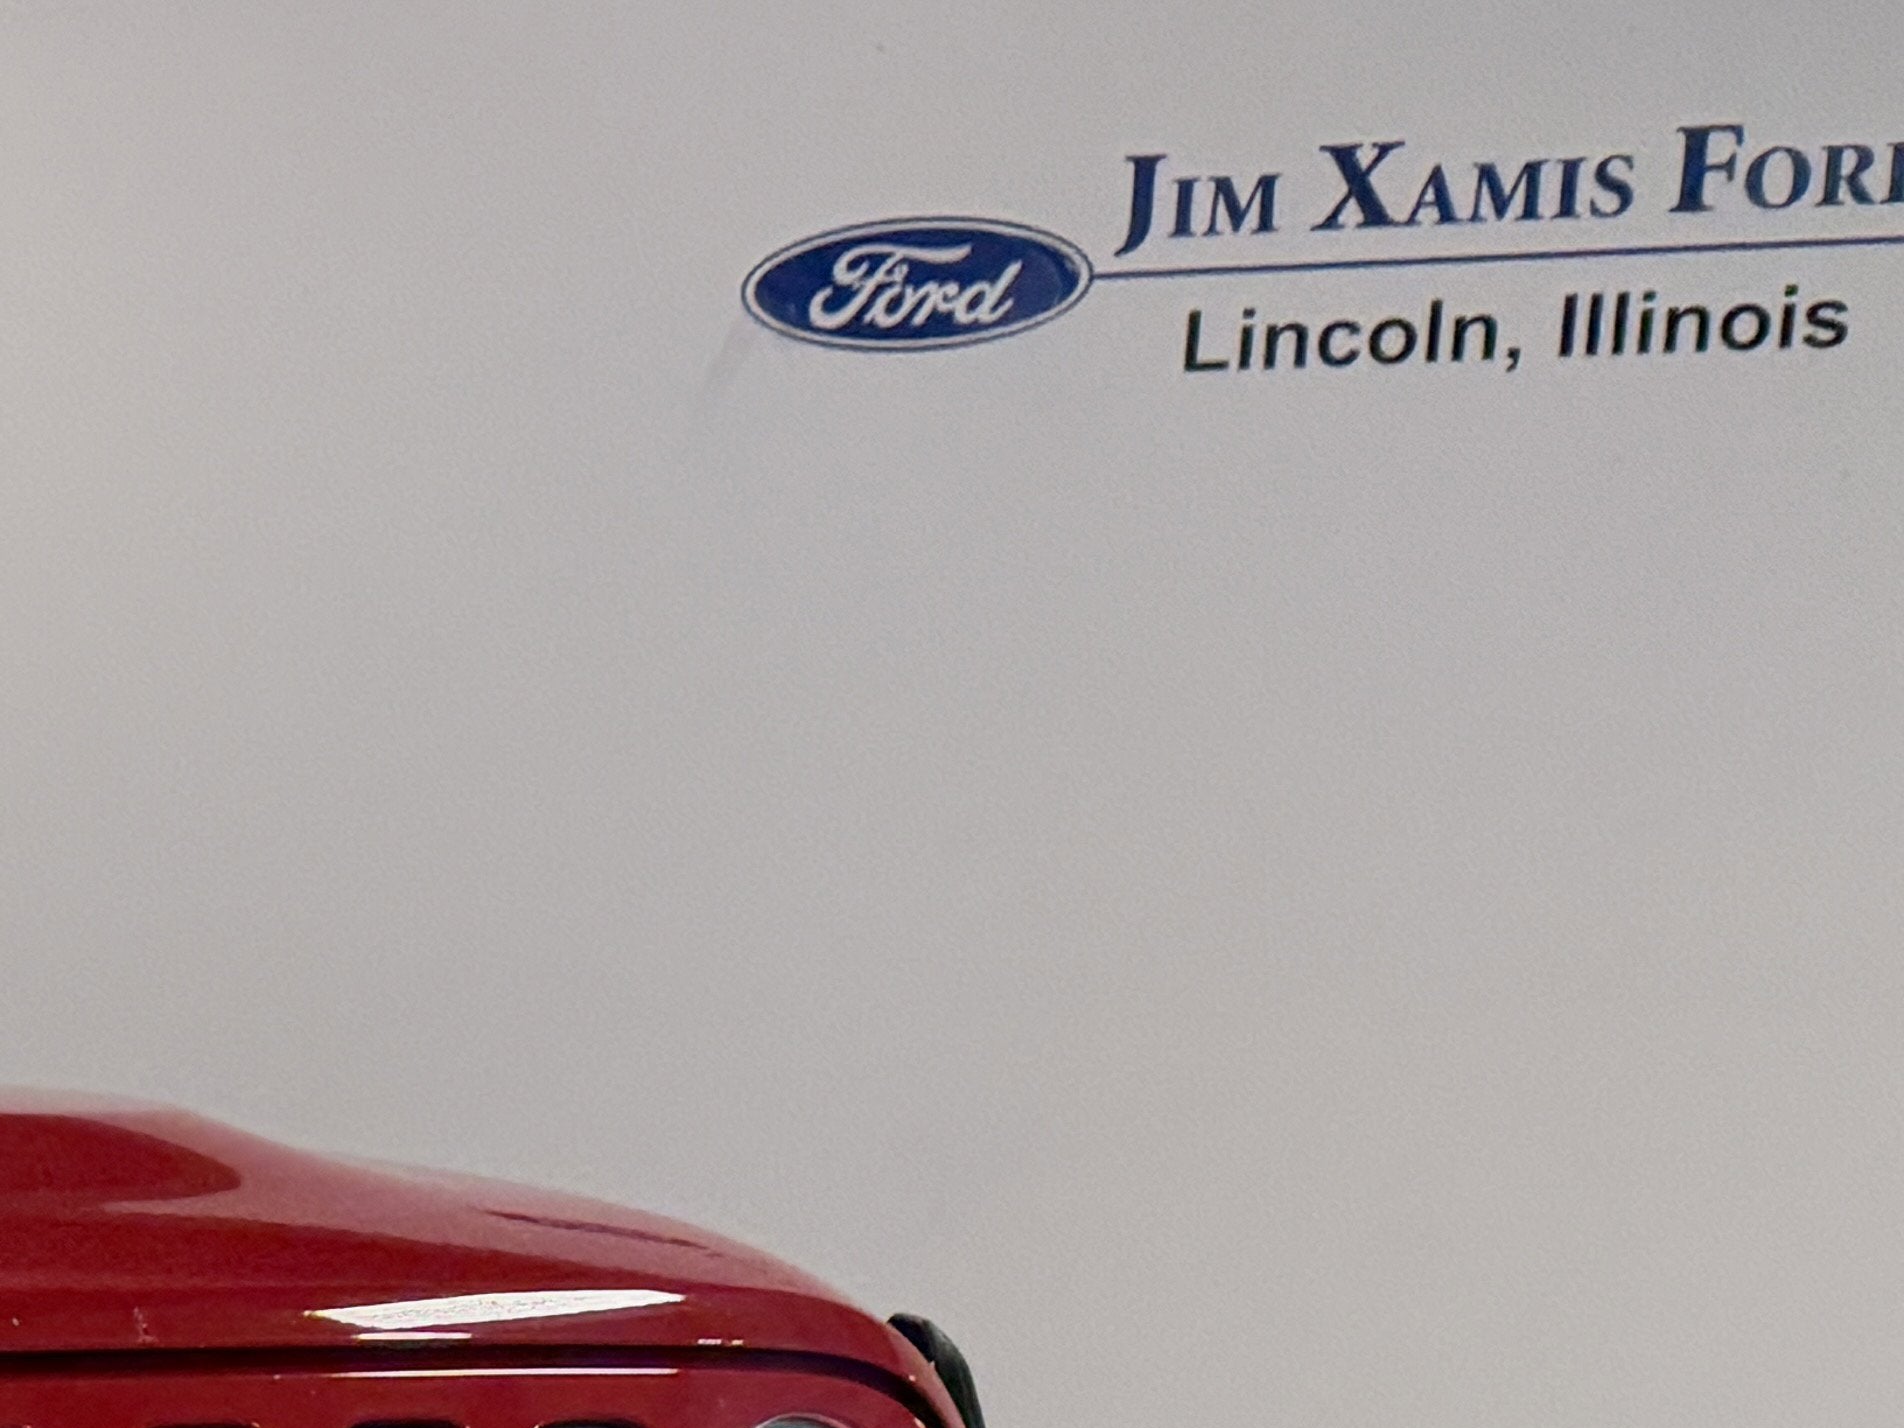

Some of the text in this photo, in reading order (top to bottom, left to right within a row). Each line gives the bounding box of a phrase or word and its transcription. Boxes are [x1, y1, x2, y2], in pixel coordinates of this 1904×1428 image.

[1113, 153, 1280, 258] JIM
[1309, 140, 1635, 233] XAMIS
[809, 244, 1023, 330] Ford
[1183, 284, 1849, 373] Lincoln, Illinois
